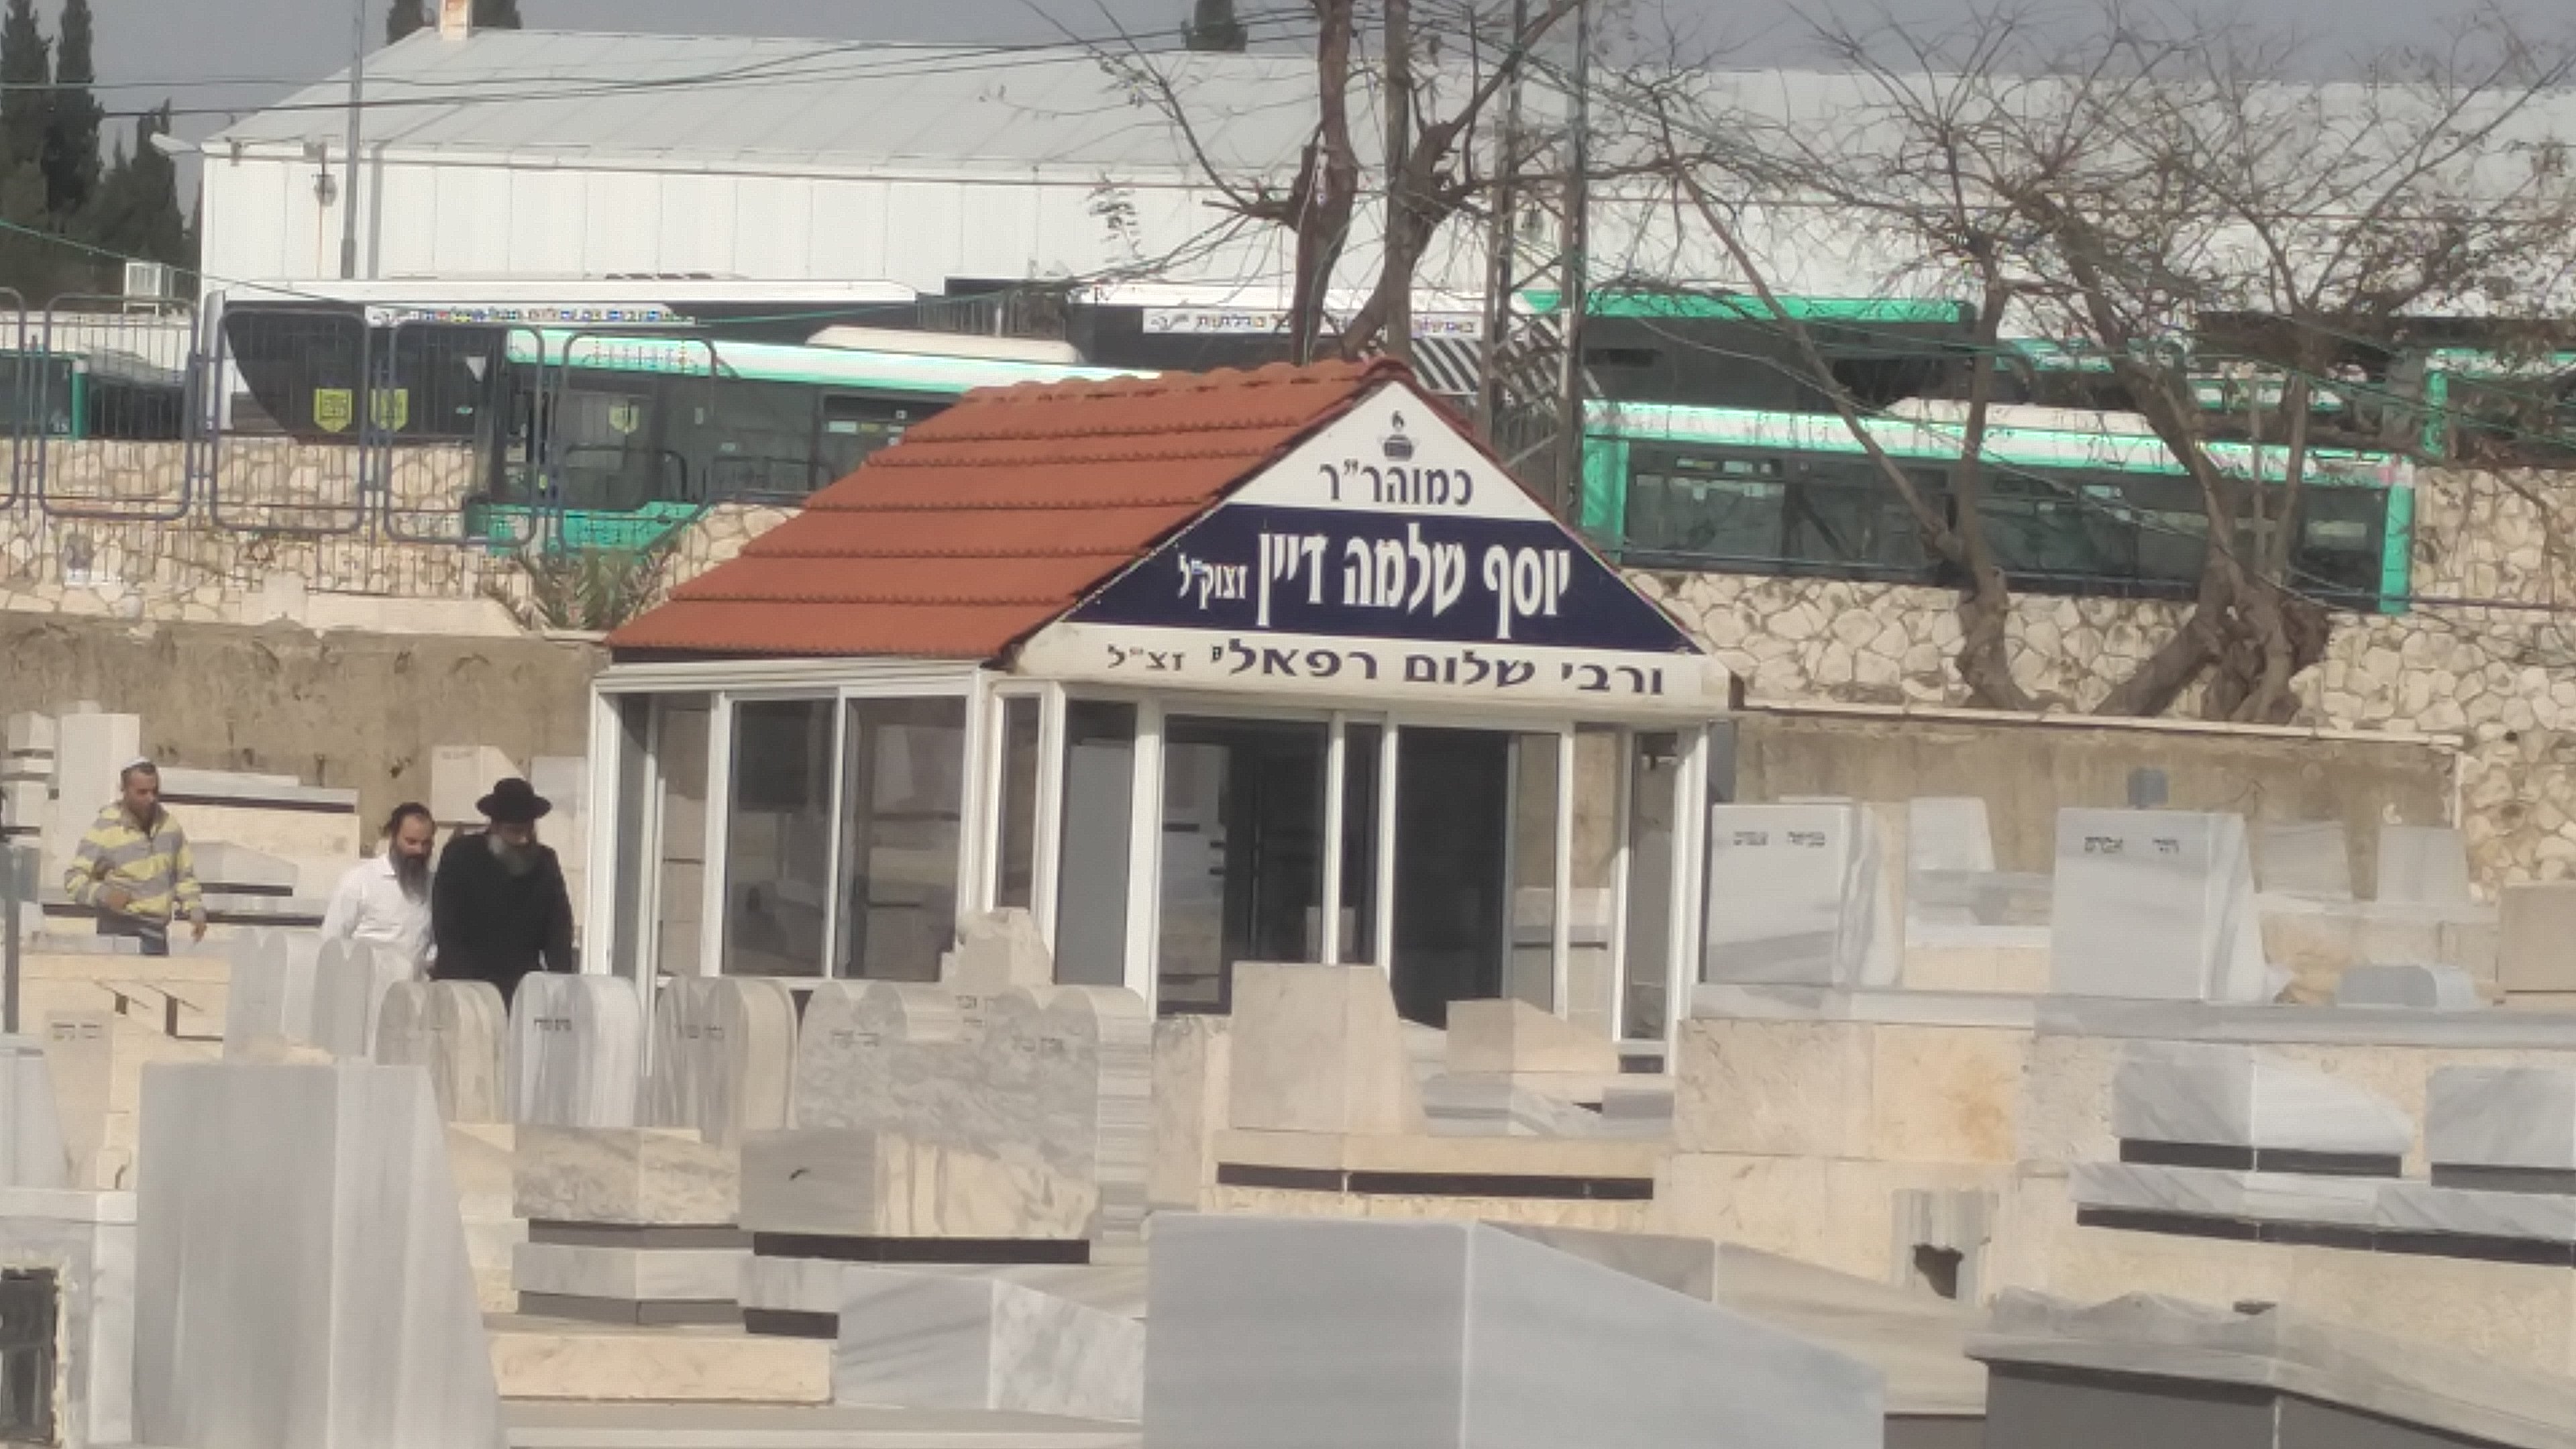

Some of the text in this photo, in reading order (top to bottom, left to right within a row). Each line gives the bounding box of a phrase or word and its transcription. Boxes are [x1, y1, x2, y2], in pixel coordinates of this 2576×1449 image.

[1319, 458, 1472, 505] כמוהר"ר
[1257, 533, 1328, 627] דיין
[1343, 523, 1466, 618] שלמה
[1483, 544, 1570, 639] יוסף
[1210, 638, 1378, 680] רפאלי
[1404, 649, 1536, 688] שלום
[1560, 661, 1664, 694] ורבי
